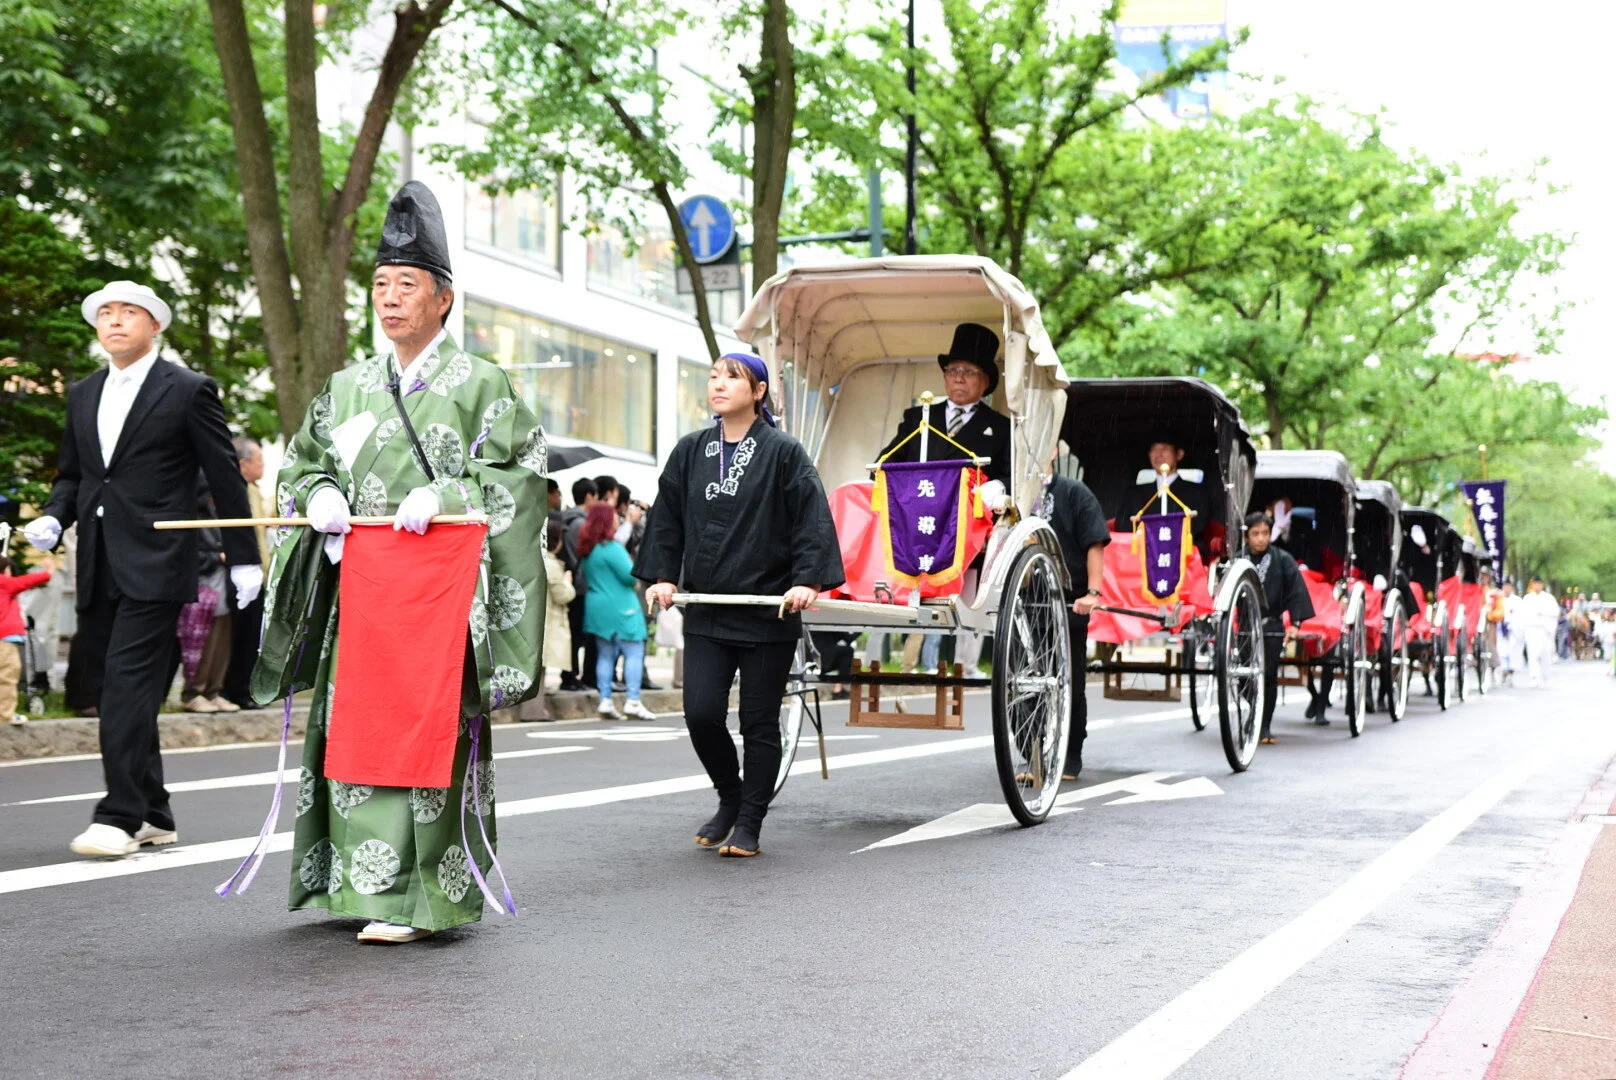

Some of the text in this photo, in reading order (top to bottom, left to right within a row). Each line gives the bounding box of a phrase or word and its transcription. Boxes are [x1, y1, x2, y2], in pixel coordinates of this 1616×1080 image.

[721, 437, 757, 496] えびす屋
[917, 479, 936, 572] 先導車
